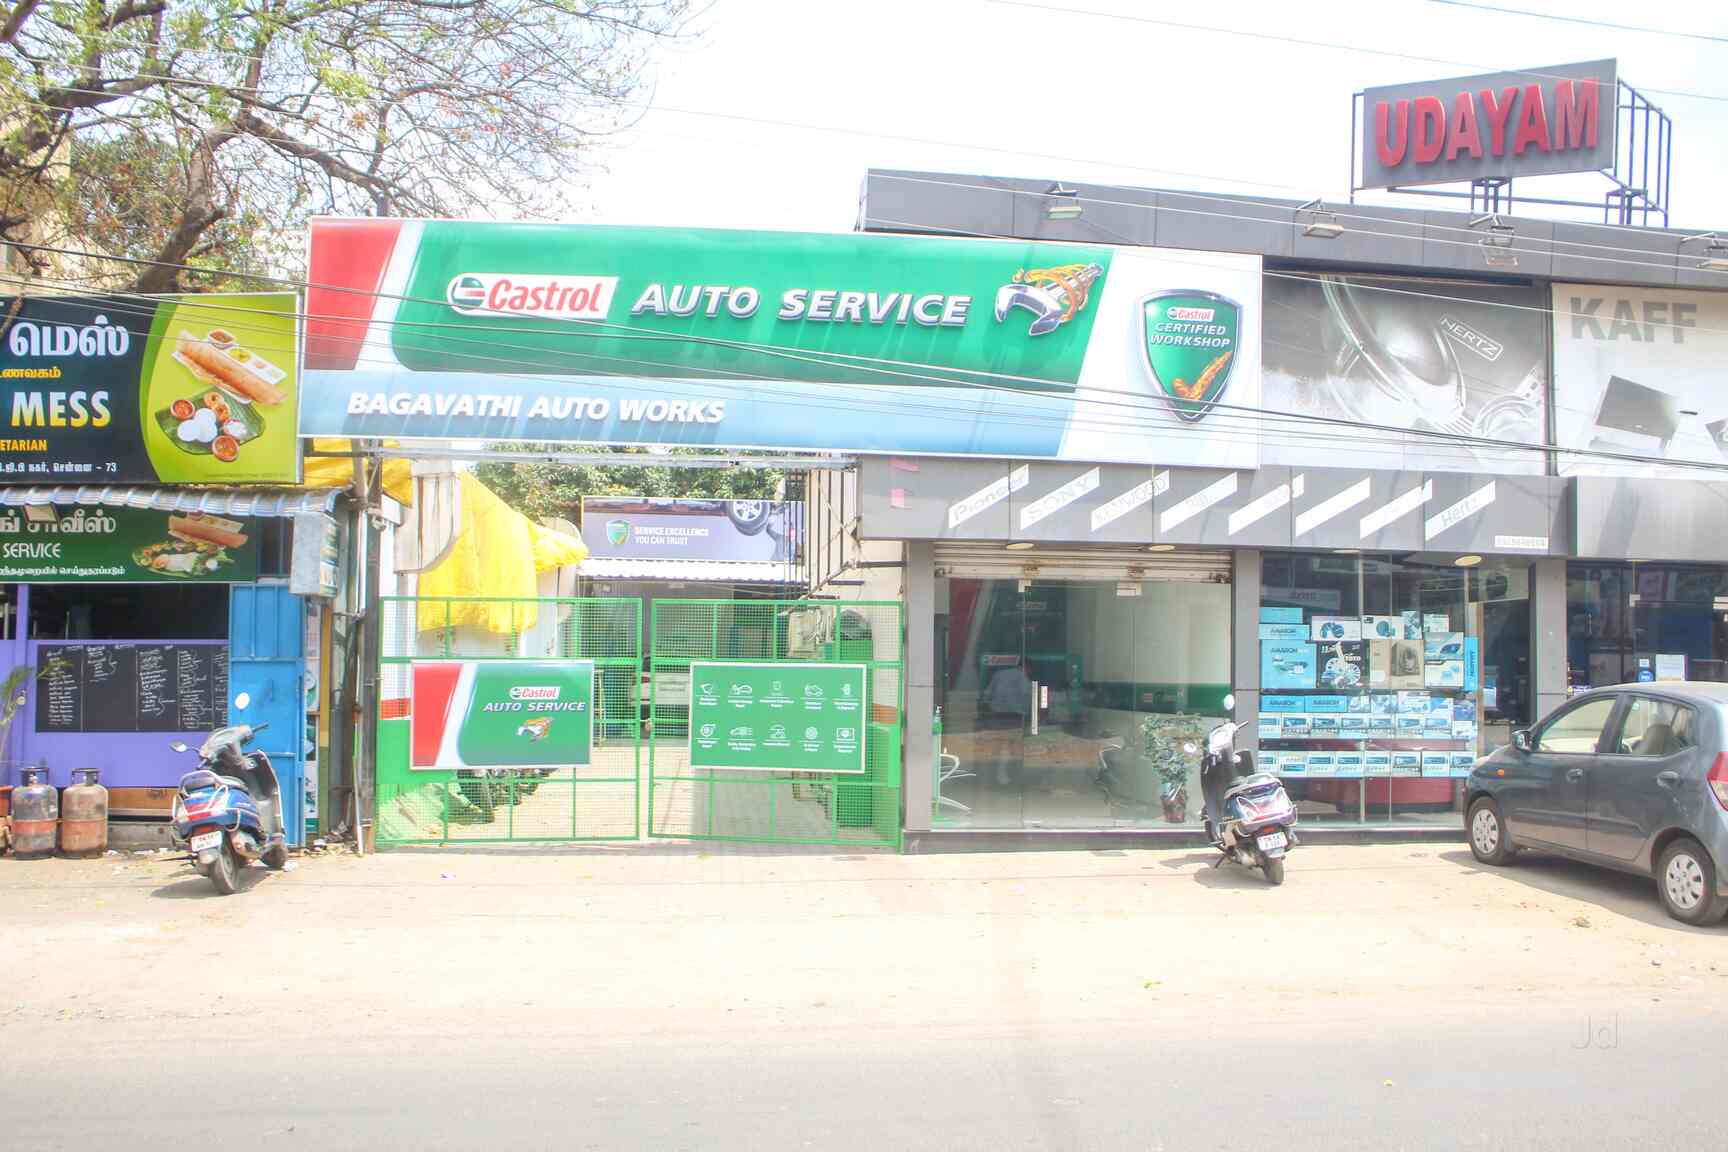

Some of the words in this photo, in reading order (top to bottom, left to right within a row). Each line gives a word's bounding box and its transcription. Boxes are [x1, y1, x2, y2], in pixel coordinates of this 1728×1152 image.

[1376, 77, 1600, 168] UDAYAM
[488, 279, 604, 312] Castrol
[631, 284, 760, 318] AUTO
[780, 288, 972, 327] SERVICE
[1178, 308, 1212, 320] Castrol
[1570, 297, 1697, 344] KAFF
[9, 313, 129, 357] மெஸ்
[1154, 323, 1226, 335] CERTIFIED
[1441, 319, 1498, 356] HERTZ
[1151, 335, 1231, 348] WORKSHOP
[0, 366, 62, 379] ணவகம்
[10, 391, 111, 427] MESS
[347, 392, 521, 418] BAGAVATHI
[527, 396, 609, 420] AUTO
[618, 400, 725, 423] WORKS
[105, 463, 117, 472] 73
[1027, 478, 1090, 521] SONY
[634, 527, 664, 536] SERVICE
[665, 527, 709, 537] EXCELLENCE
[2, 542, 62, 559] SERVICE
[522, 687, 557, 698] Castrol
[483, 702, 522, 712] AUTO
[527, 702, 586, 711] SERVICE
